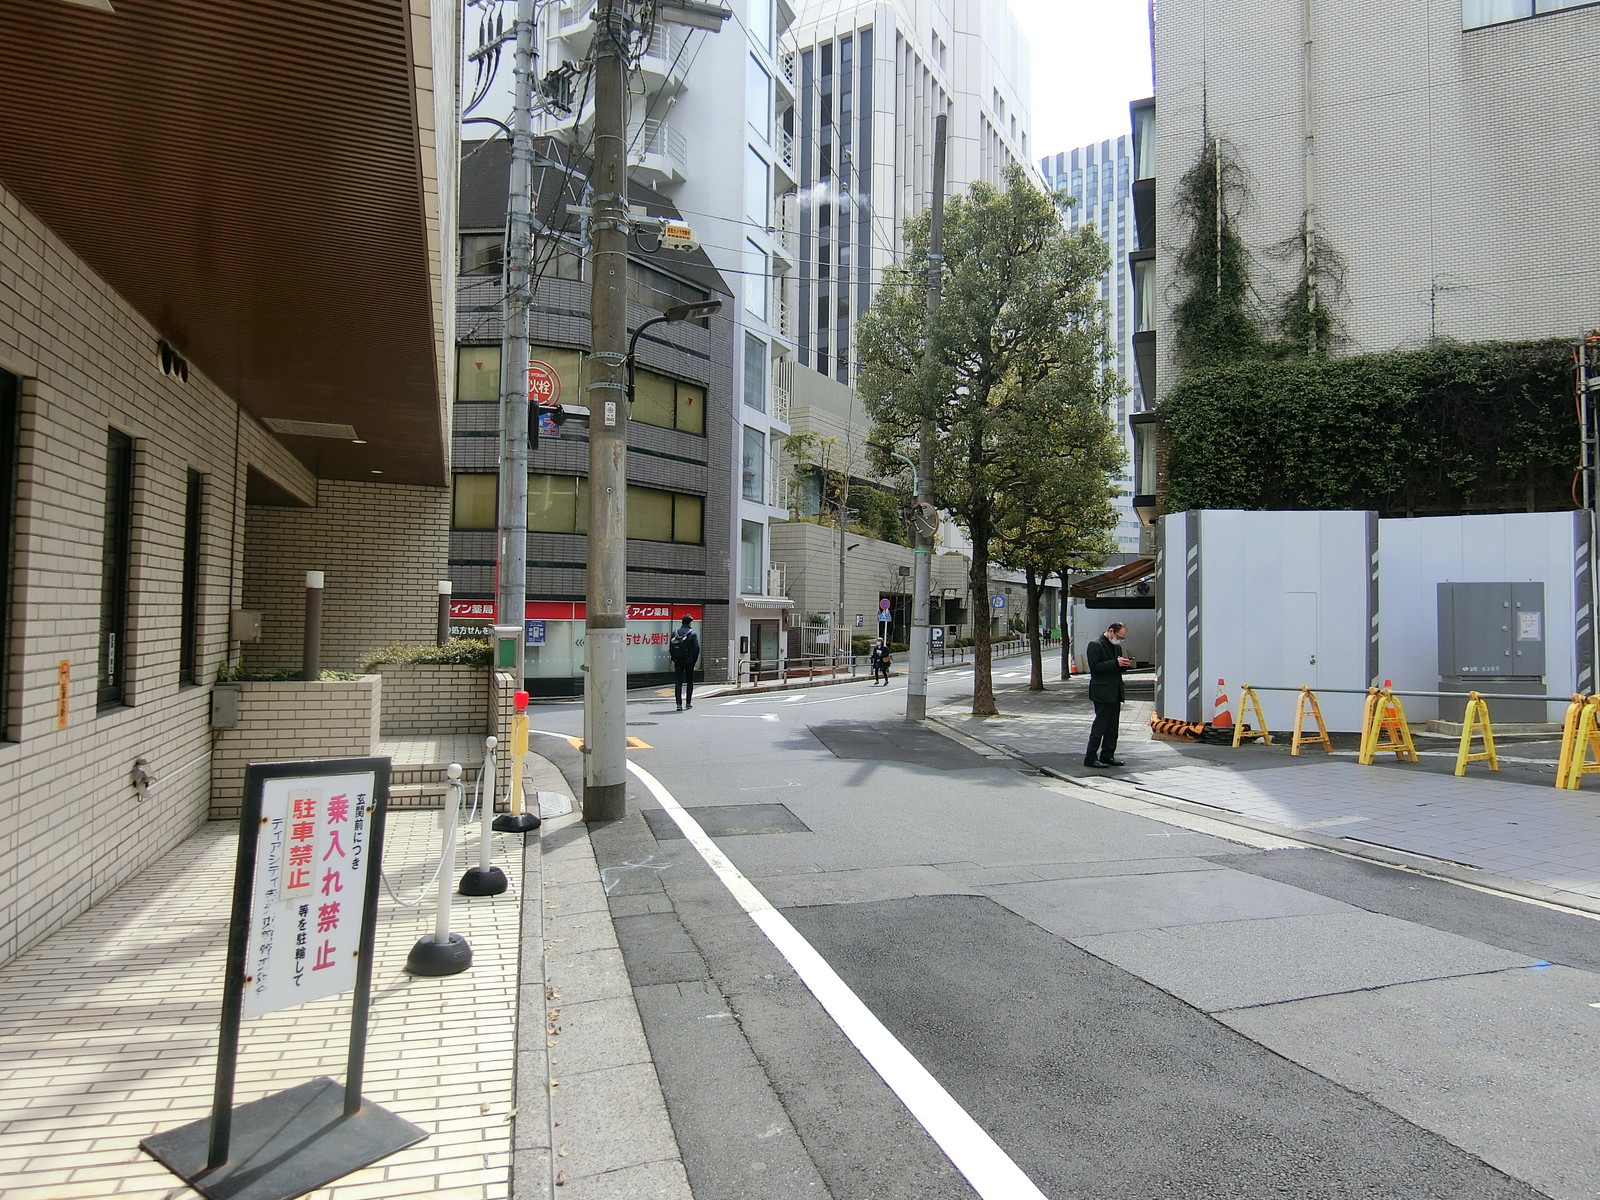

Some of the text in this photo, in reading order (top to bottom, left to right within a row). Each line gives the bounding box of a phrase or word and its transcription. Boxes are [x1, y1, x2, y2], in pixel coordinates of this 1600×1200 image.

[528, 379, 551, 395] 火栓
[449, 604, 494, 614] イン薬局
[632, 607, 670, 617] アイン薬局
[932, 628, 943, 640] P
[287, 798, 317, 890] 駐車禁止
[351, 793, 366, 870] 玄関前につき
[312, 793, 349, 971] 乗入れ禁止
[293, 904, 309, 987] 等を駐輪して
